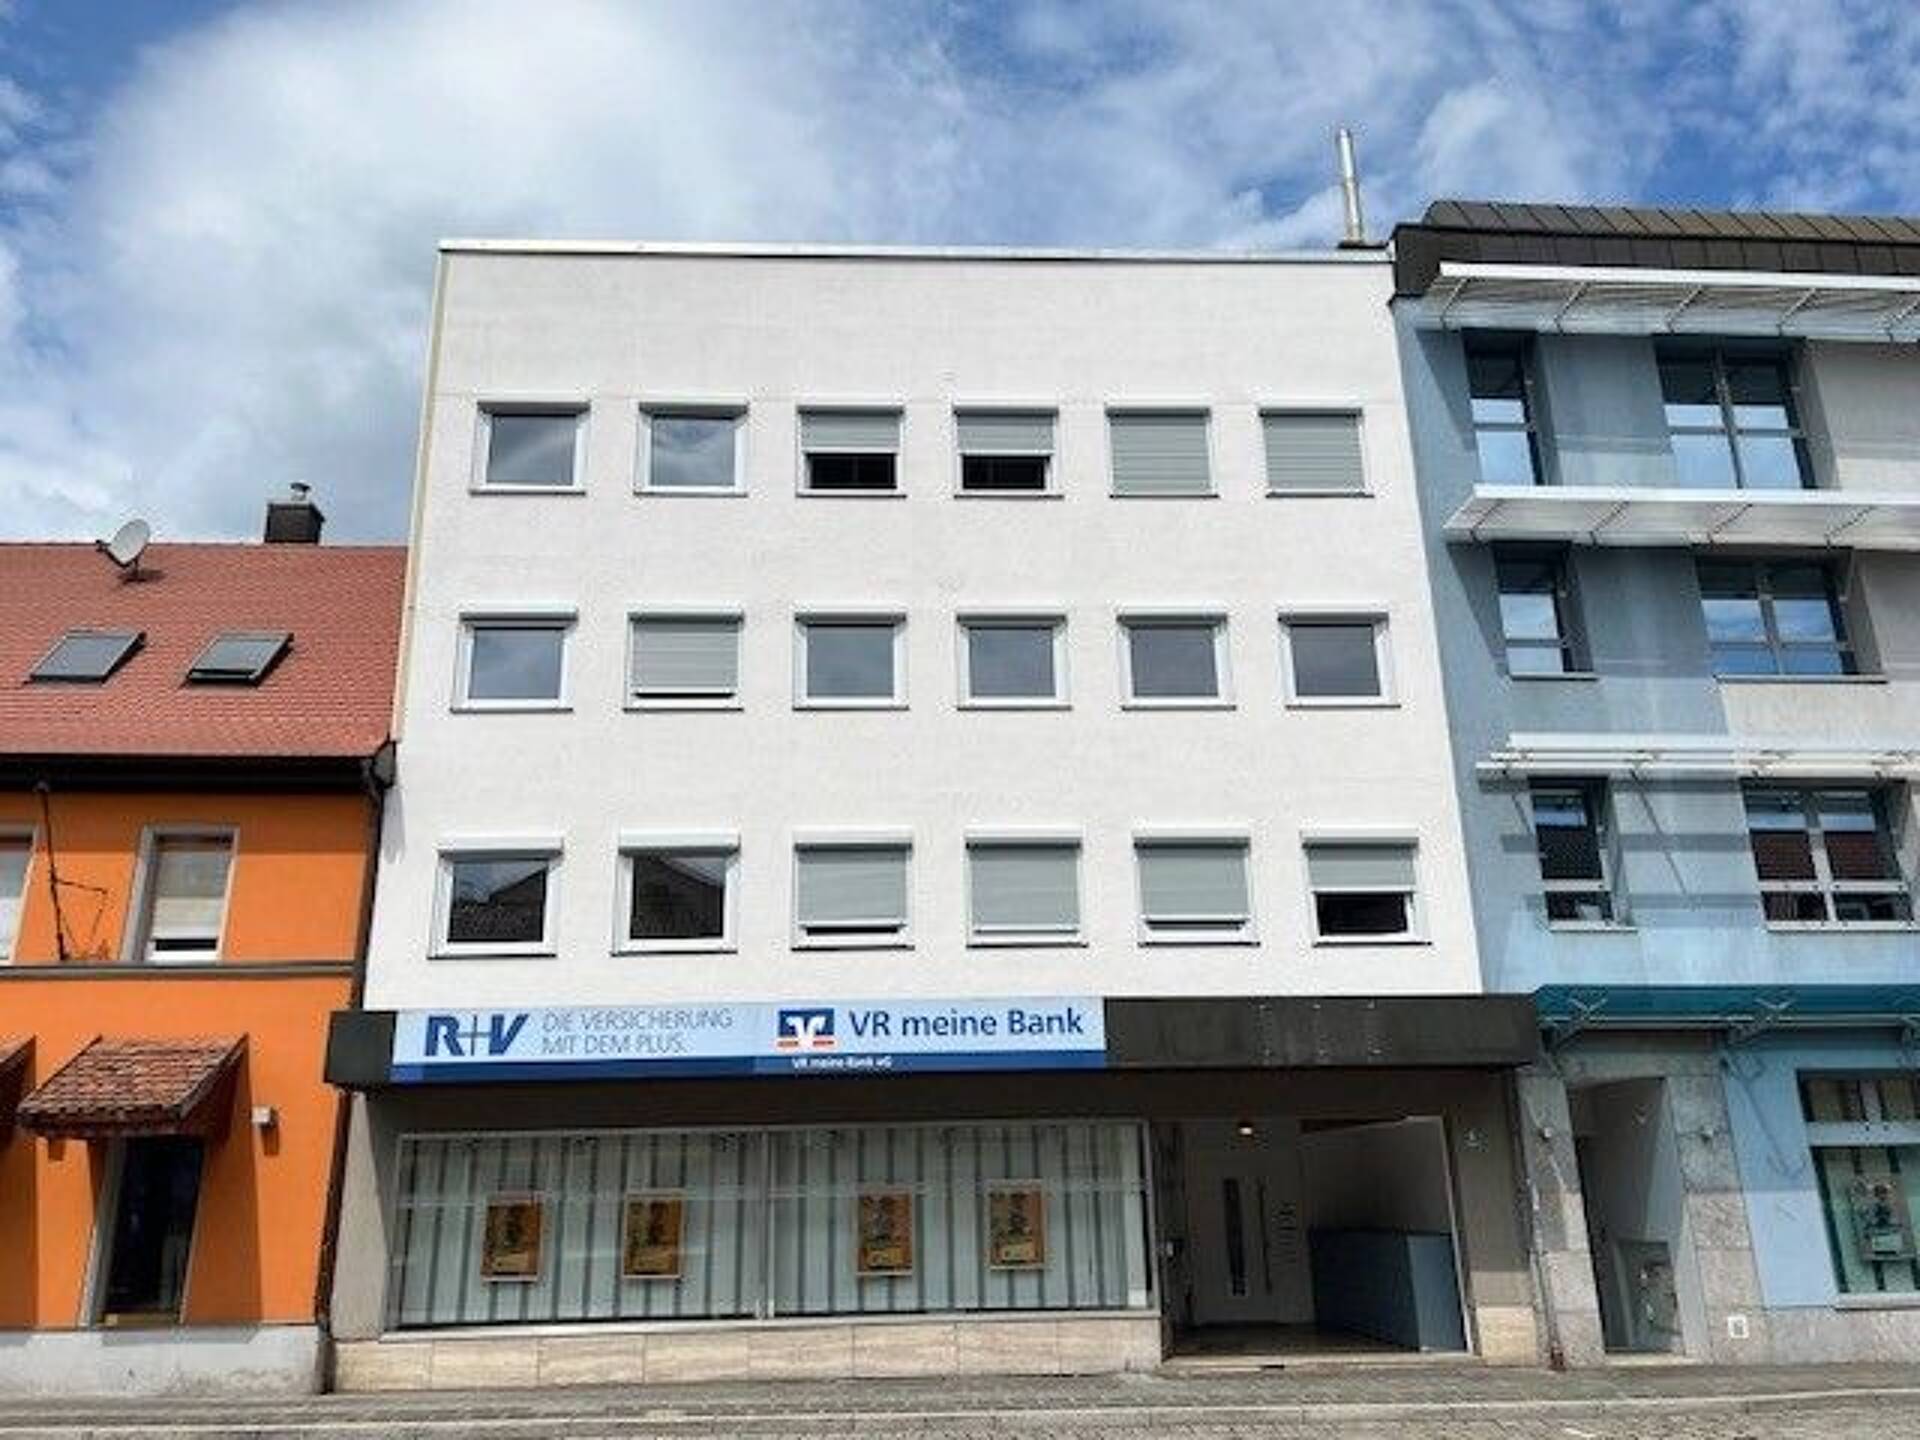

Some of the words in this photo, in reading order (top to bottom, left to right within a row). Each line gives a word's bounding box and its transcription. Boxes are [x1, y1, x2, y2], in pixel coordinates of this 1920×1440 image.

[543, 1010, 572, 1031] DIE
[581, 1007, 733, 1031] VERSICHERUNG
[850, 1010, 891, 1037] VR
[901, 1010, 998, 1037] meine
[1008, 1007, 1084, 1036] Bank
[425, 1014, 530, 1057] R+V
[543, 1035, 576, 1054] MIT
[584, 1034, 631, 1053] DEM
